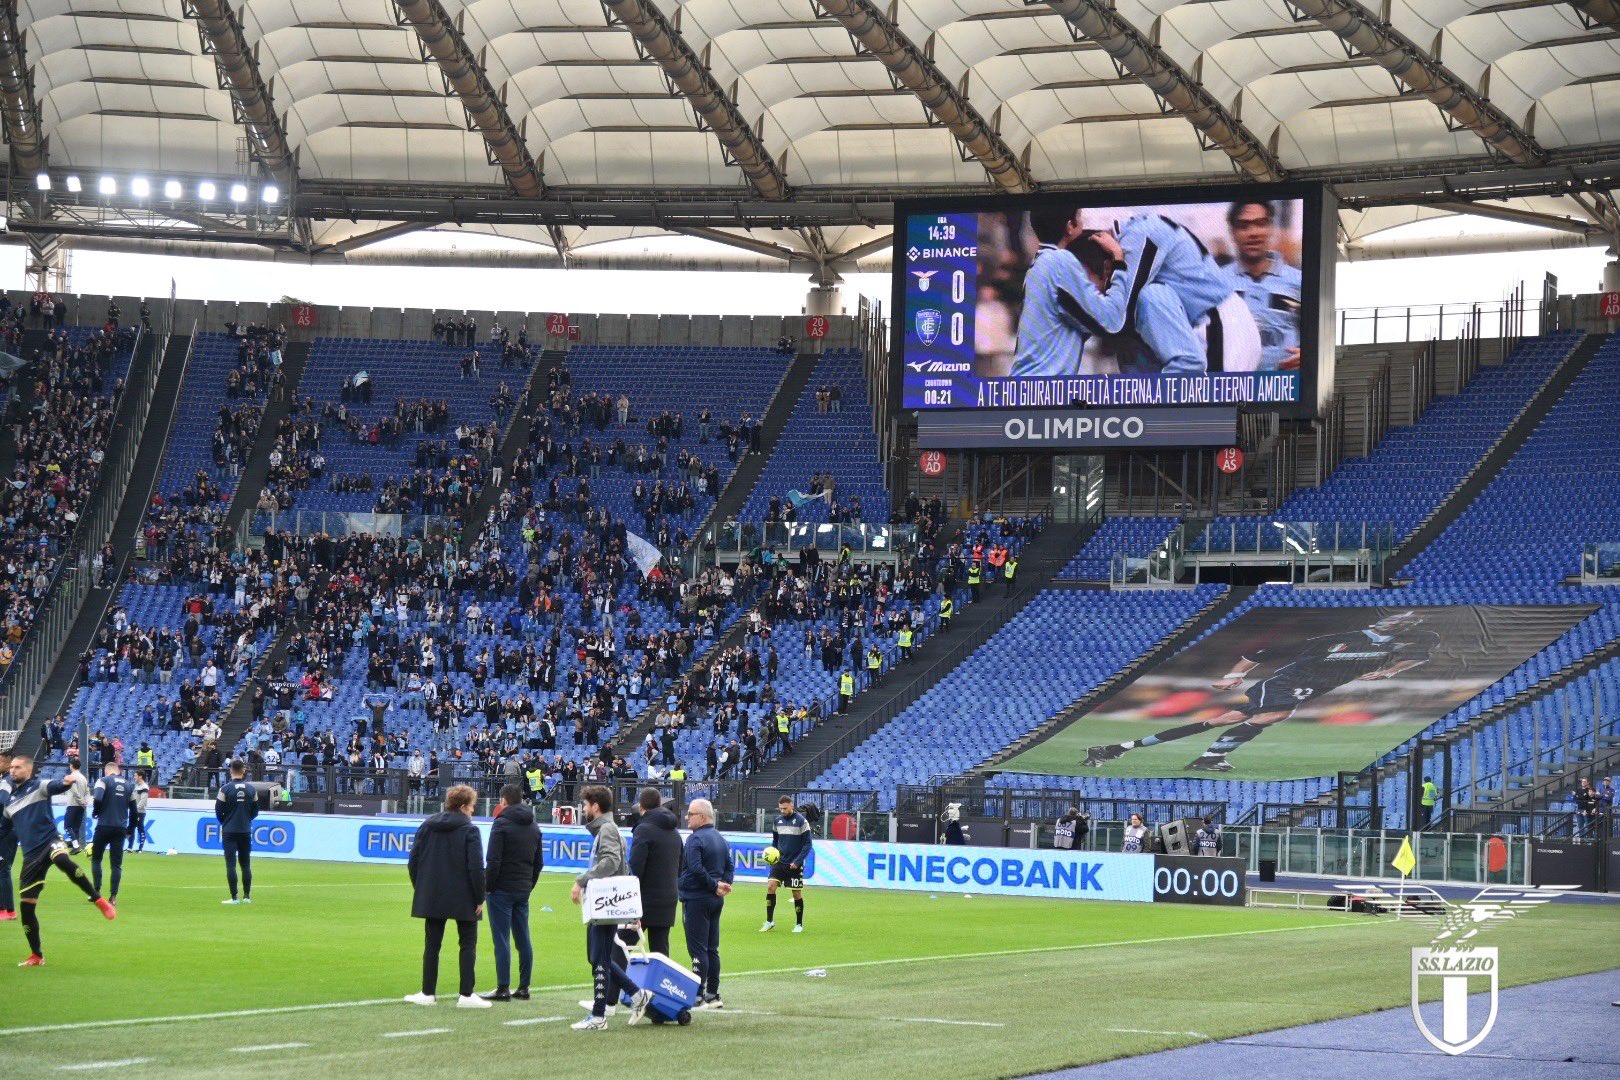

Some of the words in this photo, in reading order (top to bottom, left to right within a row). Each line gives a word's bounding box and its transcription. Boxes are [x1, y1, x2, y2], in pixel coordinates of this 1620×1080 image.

[928, 225, 955, 240] 14:39
[923, 247, 977, 258] BINANCE
[952, 270, 964, 303] 0
[1607, 294, 1618, 304] 19
[299, 306, 309, 315] 21
[1605, 305, 1619, 315] AD
[298, 316, 310, 325] AS
[553, 315, 563, 324] 21
[813, 318, 823, 326] 20
[551, 325, 564, 334] AD
[811, 327, 824, 336] AS
[951, 312, 964, 345] 0
[978, 382, 984, 407] A
[988, 382, 999, 406] TE
[1002, 381, 1016, 406] HO
[1020, 380, 1064, 406] GIURATO
[1166, 378, 1177, 403] TE
[1180, 371, 1210, 403] DARÒ
[1213, 376, 1254, 403] ETERNO
[1258, 375, 1295, 402] AMORE
[924, 389, 951, 405] 00:21
[1004, 416, 1144, 440] OLIMPICO
[927, 451, 940, 461] 20
[1223, 448, 1236, 459] 19
[925, 462, 941, 472] AD
[1222, 459, 1237, 471] AS
[868, 853, 1104, 891] FINECOBANK
[791, 878, 799, 888] 10
[1154, 867, 1239, 898] 00:00
[594, 891, 632, 911] Sixtus
